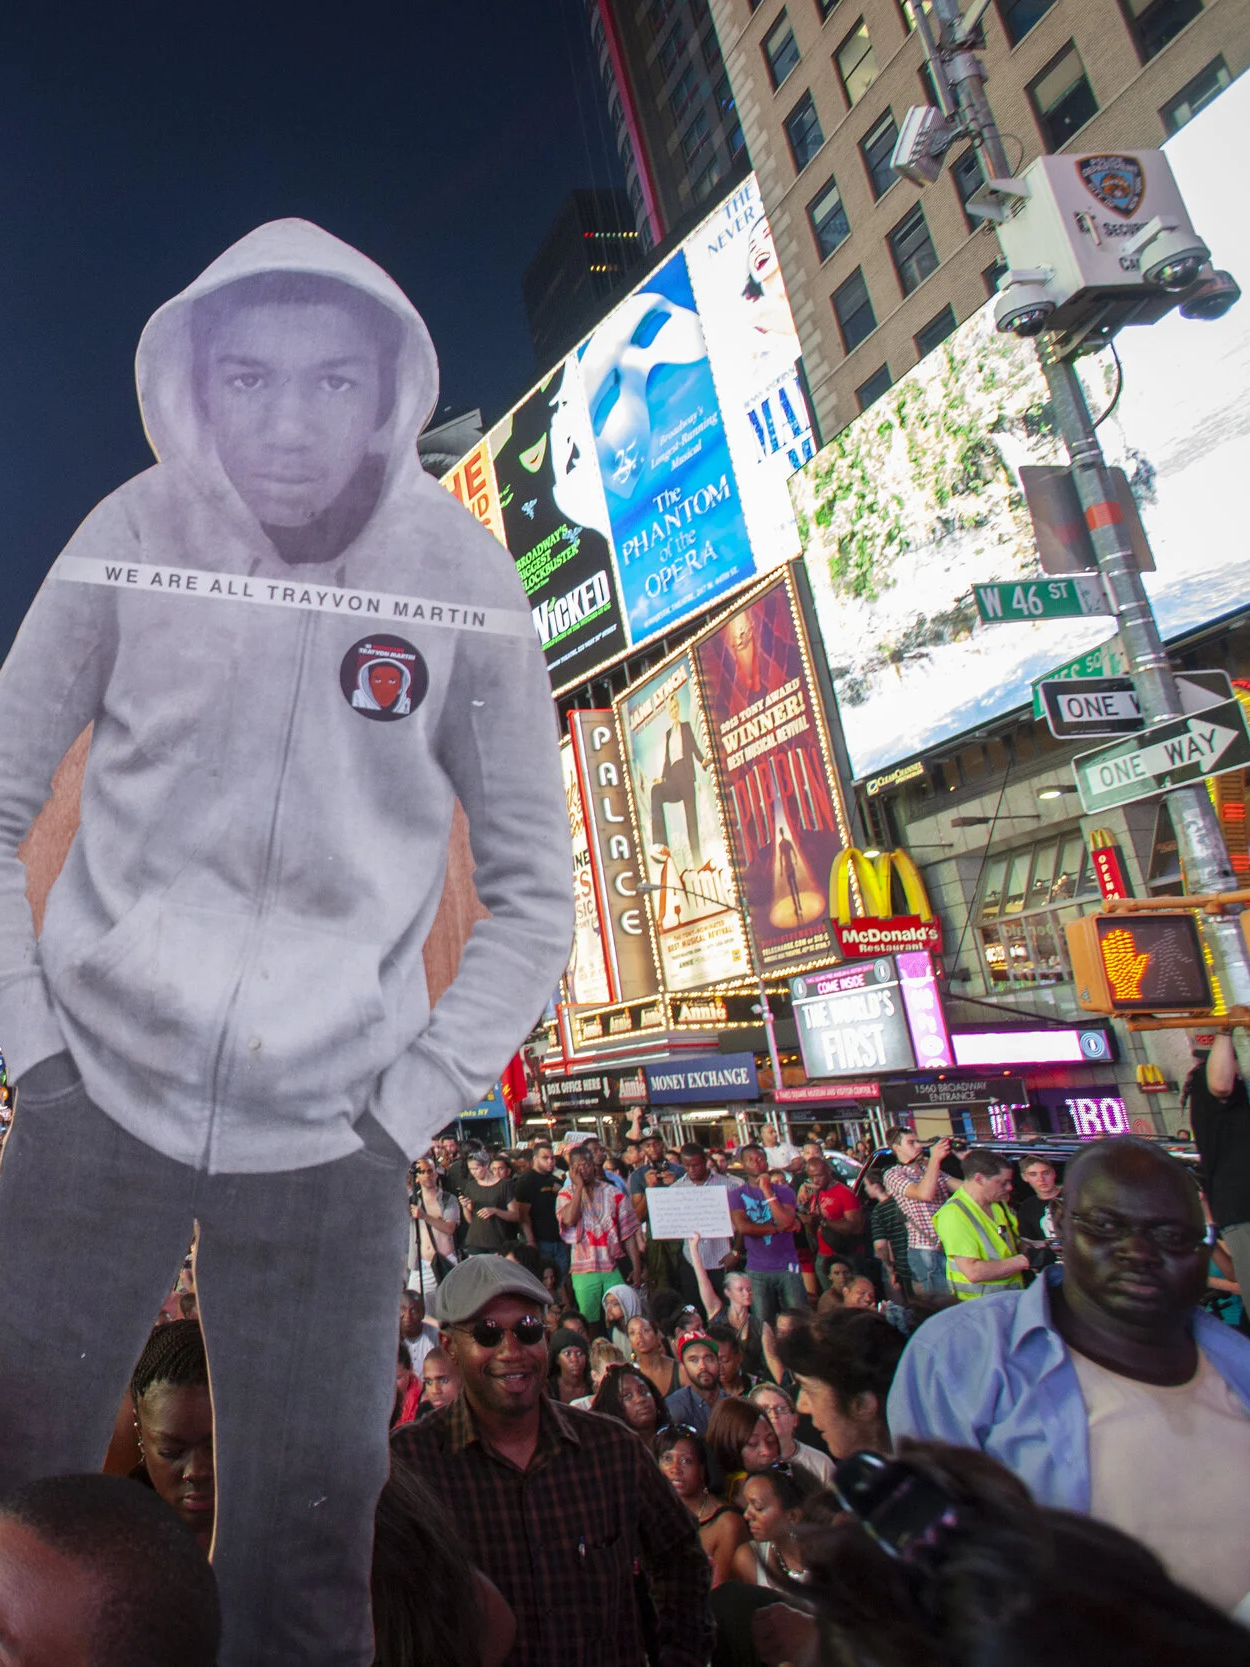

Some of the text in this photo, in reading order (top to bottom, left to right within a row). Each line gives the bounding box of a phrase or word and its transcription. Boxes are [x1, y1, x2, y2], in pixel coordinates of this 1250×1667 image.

[722, 186, 753, 220] THE
[707, 207, 756, 255] NEVER
[671, 438, 703, 472] Musical
[444, 451, 487, 504] HE
[653, 486, 682, 514] The
[621, 473, 731, 566] PHANTOM
[515, 523, 568, 572] BROADWAY'S
[659, 527, 697, 563] of the
[645, 539, 719, 598] OPERA
[105, 566, 487, 627] WE ARE ALL TRAYVON MARTIN
[980, 582, 1068, 618] W 46 ST
[358, 647, 390, 657] TRAYVON
[390, 651, 416, 661] MARTIN
[653, 665, 688, 707] LYNCH
[739, 700, 766, 722] TONY
[765, 677, 800, 709] AWARD
[722, 692, 806, 754] WINNER!
[1067, 695, 1120, 719] ONE
[776, 714, 810, 746] REVIVAL
[1099, 727, 1217, 788] ONE WAY
[728, 747, 836, 870] PIPPIN
[591, 726, 643, 936] PALACE
[1098, 854, 1114, 891] OPEN
[656, 852, 736, 932] Annie
[842, 928, 939, 944] McDonald's
[859, 942, 924, 953] Restaurant
[817, 979, 841, 995] COME
[840, 973, 866, 991] INSIDE
[678, 1002, 728, 1022] Annie
[801, 1001, 831, 1030] THE
[828, 989, 895, 1026] WORLD'S
[821, 1023, 888, 1072] FIRST
[561, 1080, 583, 1094] OFFICE
[583, 1077, 601, 1091] HERE
[651, 1067, 750, 1092] MONEY EXCHANGE
[914, 1081, 987, 1095] 1560 BROADWAY
[929, 1091, 977, 1102] ENTRANCE
